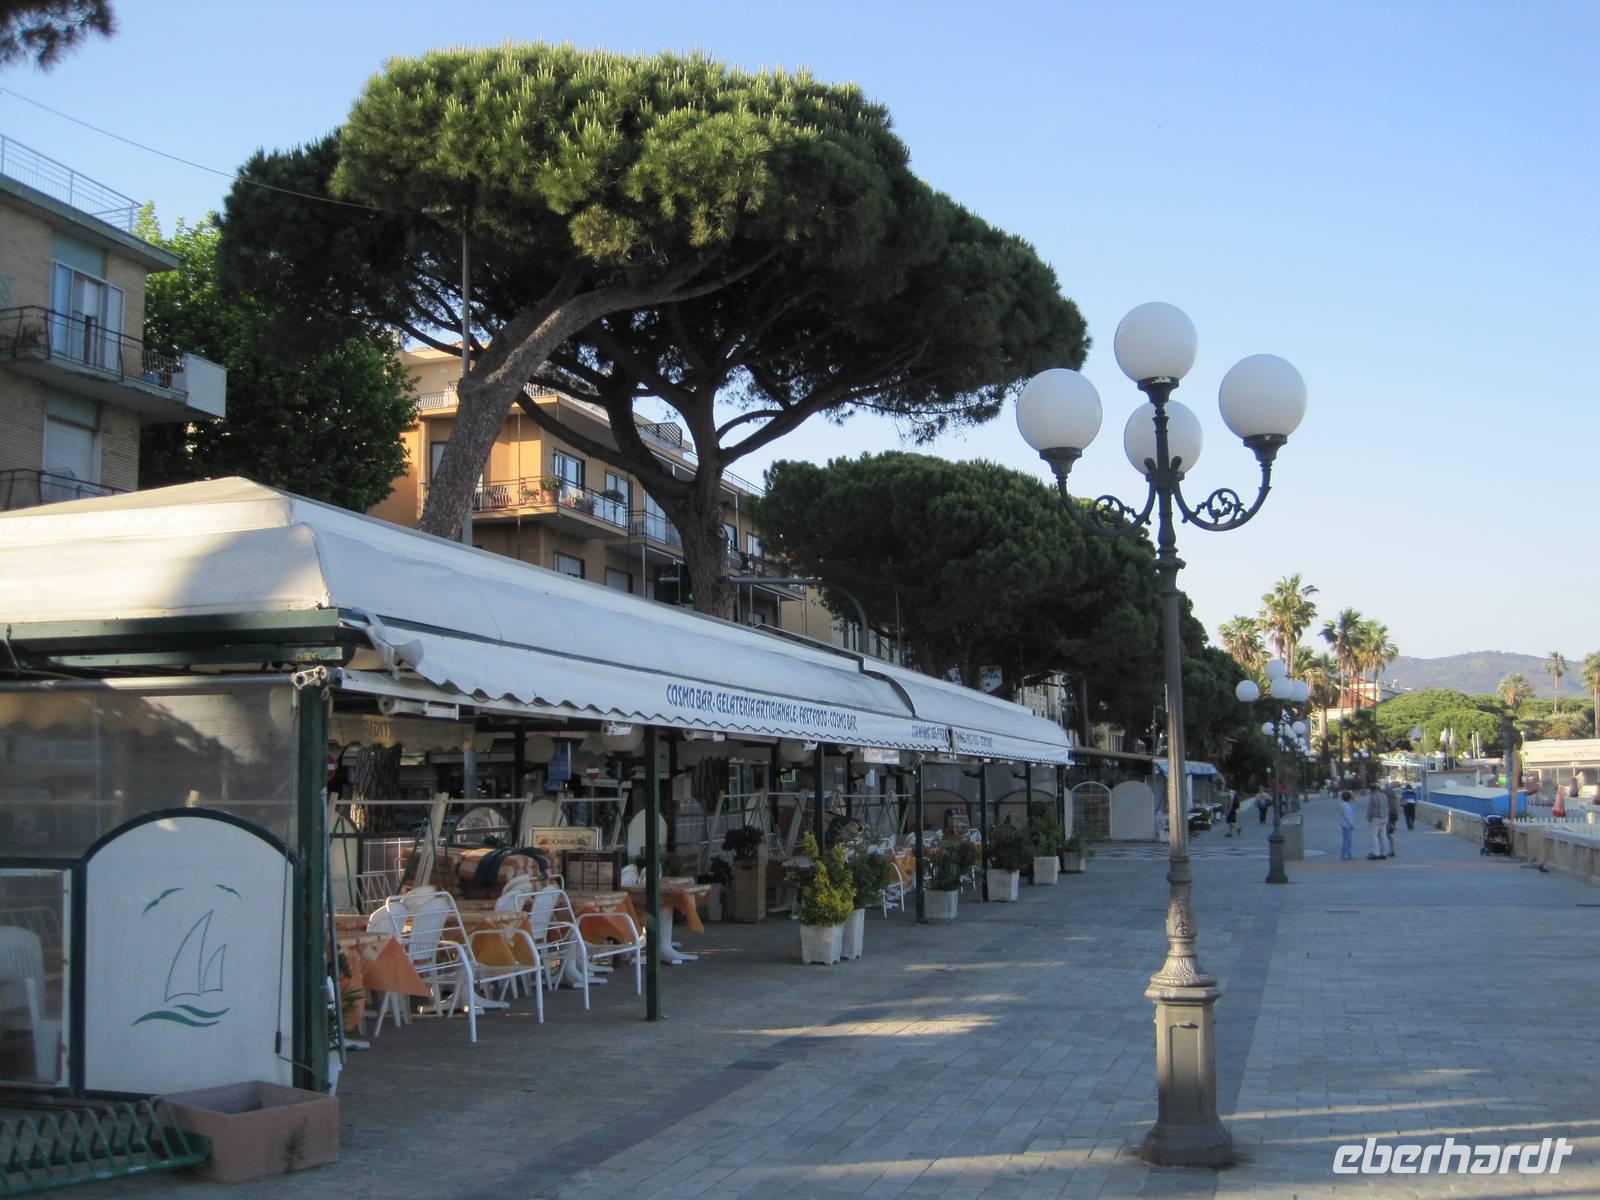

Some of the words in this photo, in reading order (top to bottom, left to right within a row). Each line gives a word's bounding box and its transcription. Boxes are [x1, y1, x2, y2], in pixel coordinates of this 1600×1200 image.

[666, 684, 695, 708] COSMO
[695, 688, 714, 713] BAR
[716, 692, 755, 719] GELATERIA
[755, 699, 797, 723] ARTIGIANALE
[799, 706, 813, 728] FAST
[813, 709, 828, 728] FOOD
[829, 712, 847, 730] COSMO
[847, 715, 859, 733] BAR
